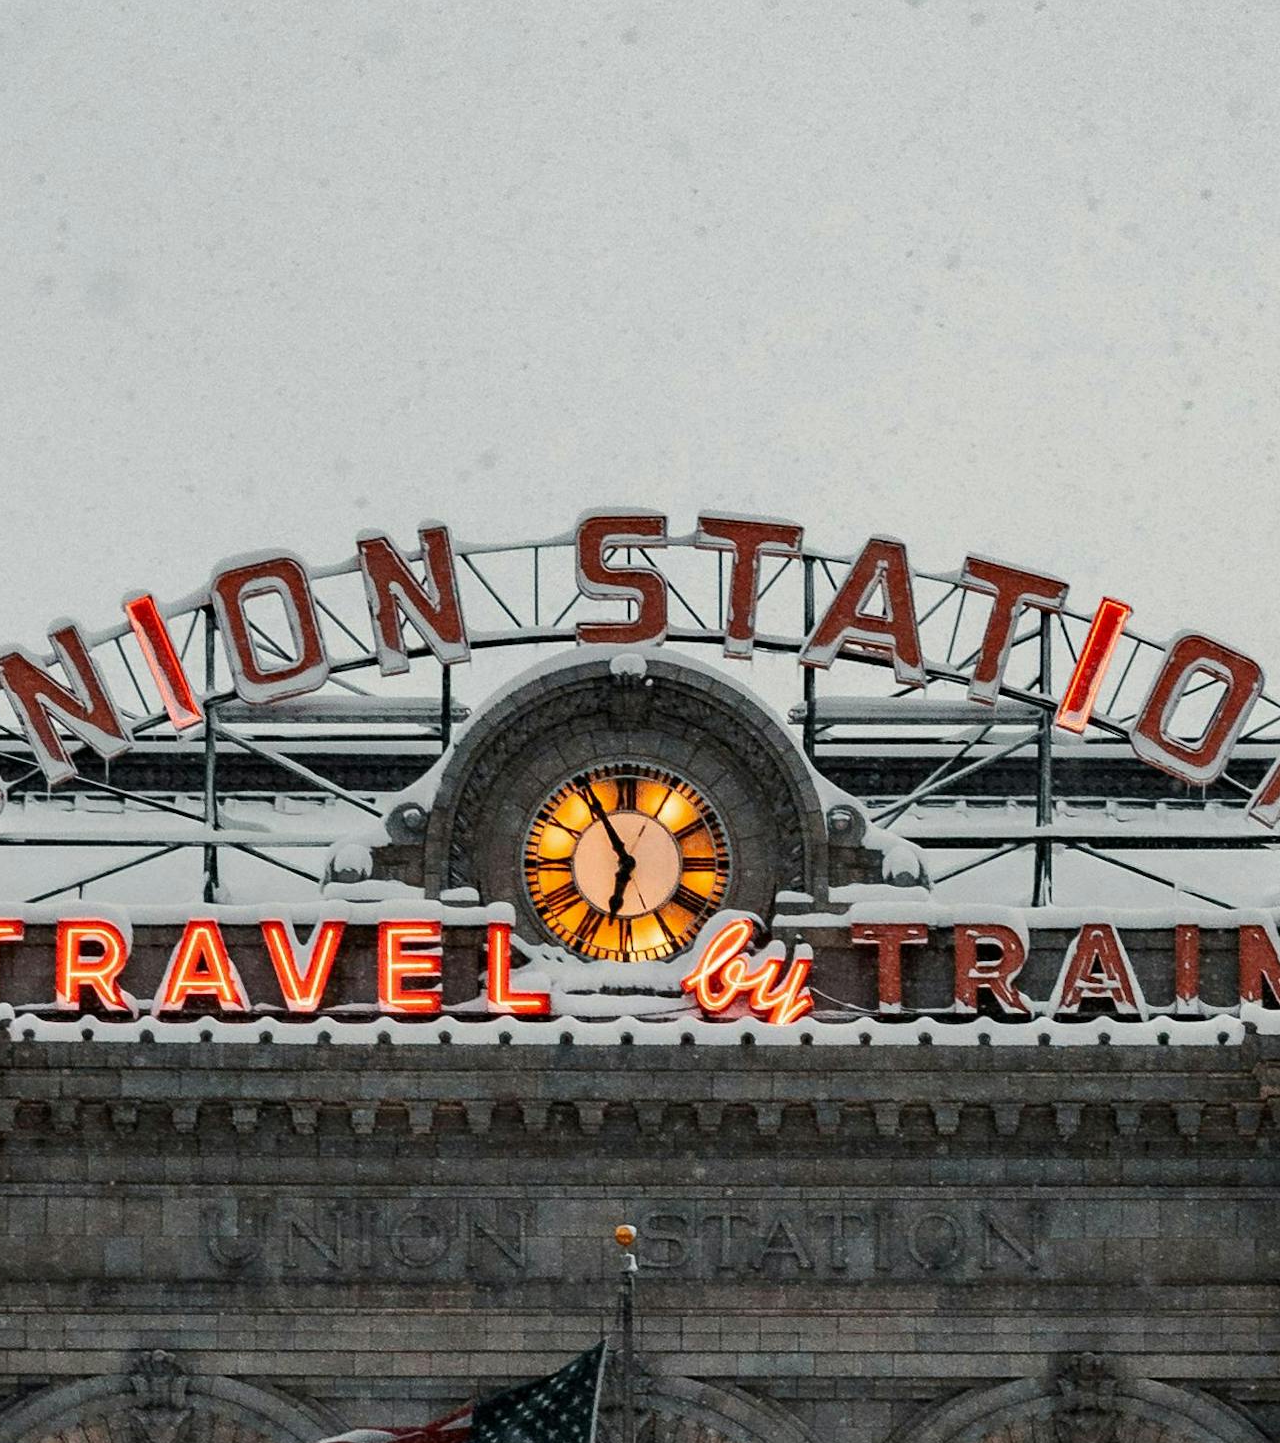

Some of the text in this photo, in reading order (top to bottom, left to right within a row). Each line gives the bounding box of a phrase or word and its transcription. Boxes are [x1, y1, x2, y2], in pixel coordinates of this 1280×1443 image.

[681, 917, 815, 1025] by
[204, 1207, 1049, 1271] UNION STATION
